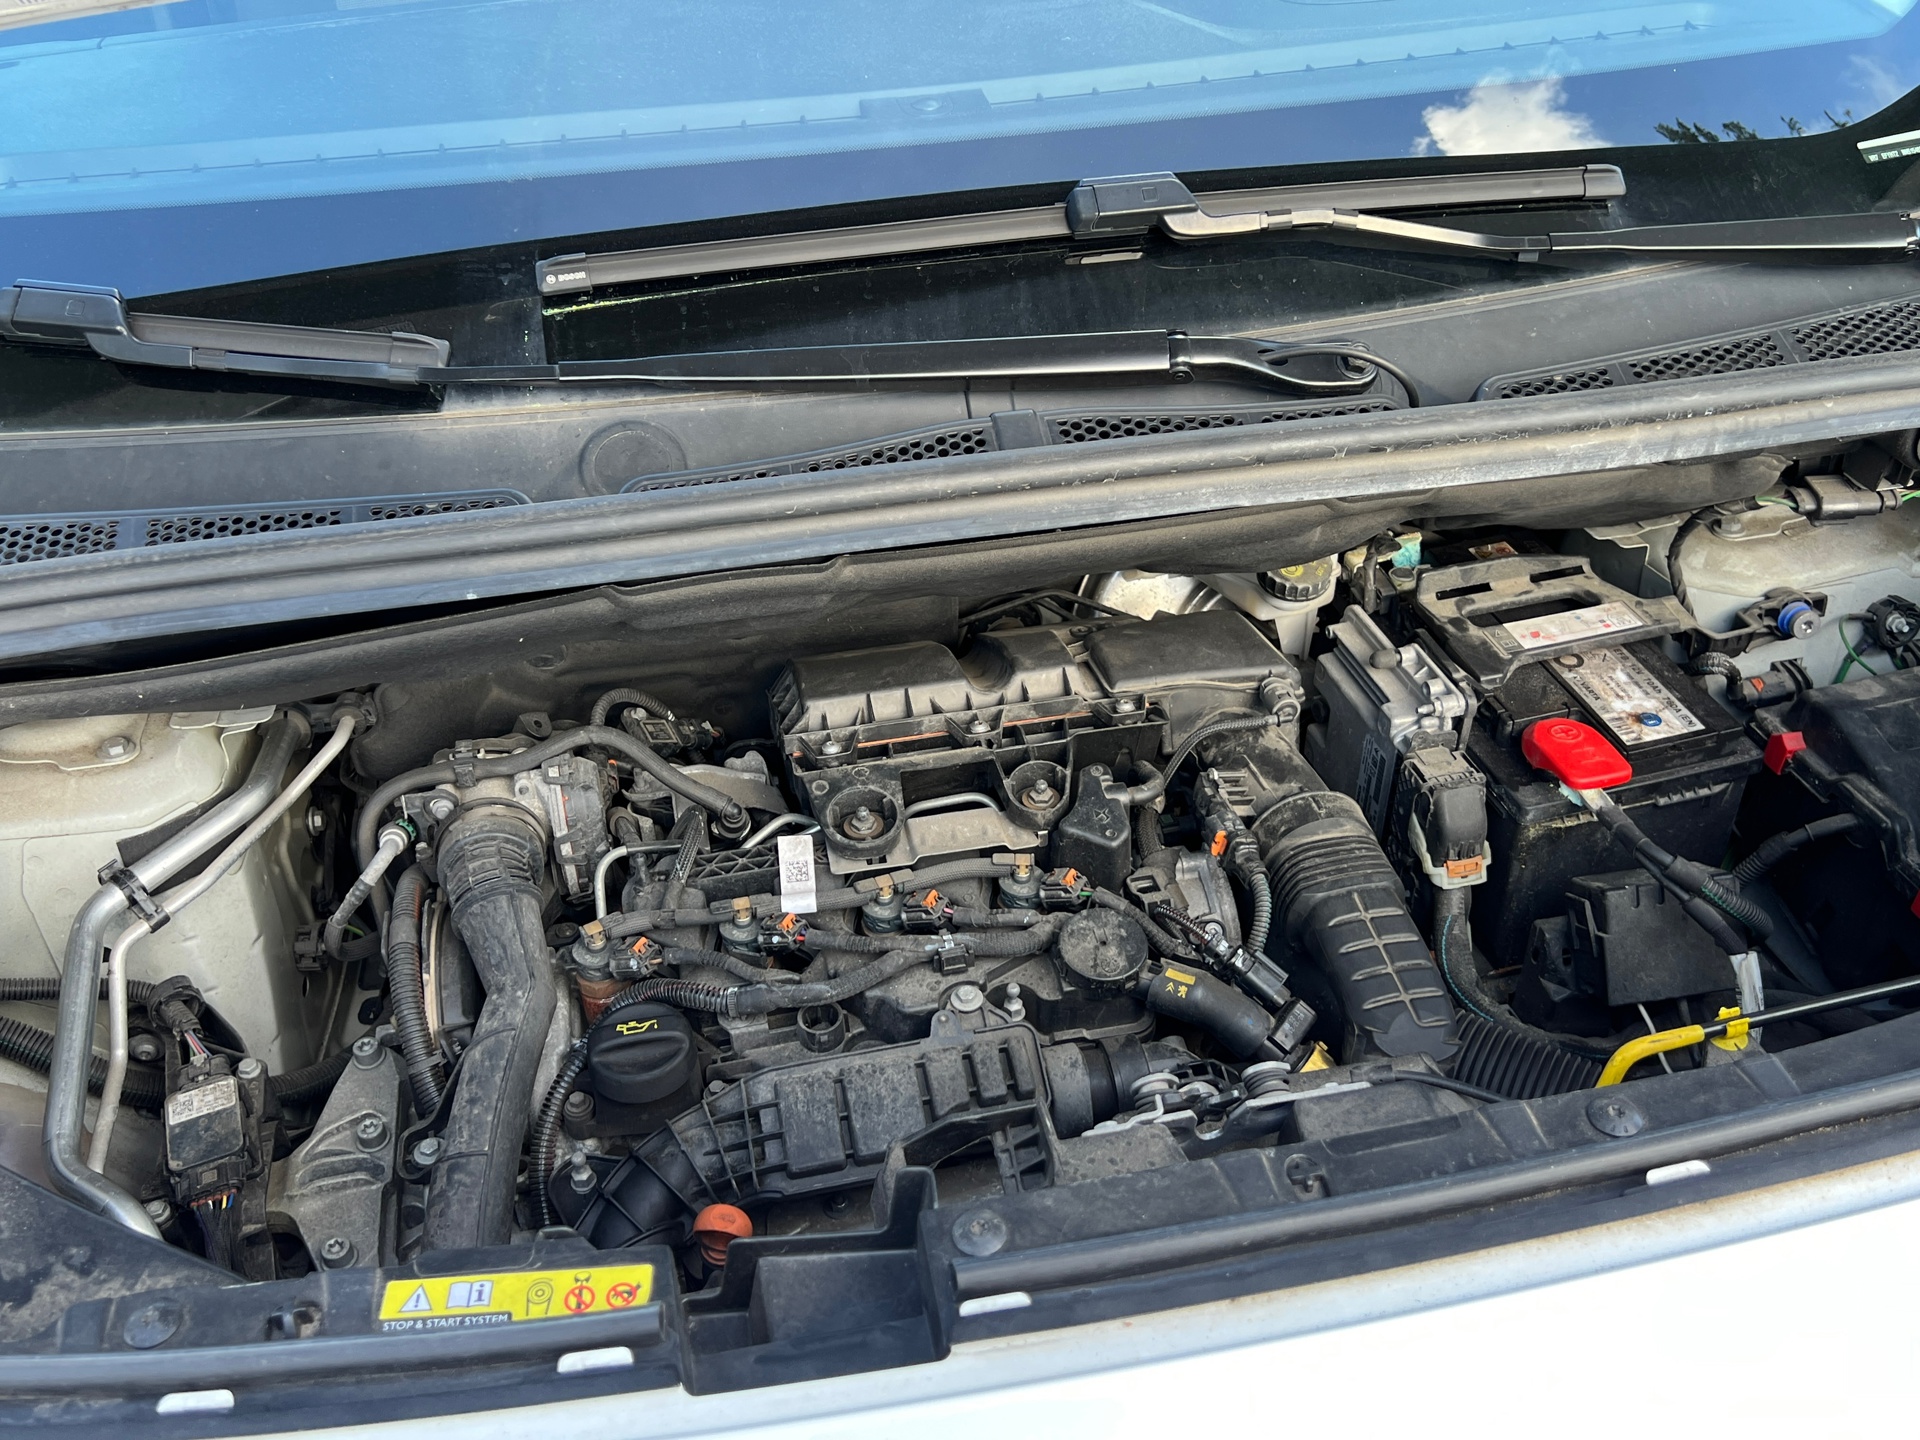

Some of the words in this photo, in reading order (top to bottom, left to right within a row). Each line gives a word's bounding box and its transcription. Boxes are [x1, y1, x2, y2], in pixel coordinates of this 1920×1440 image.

[557, 271, 586, 282] BOSCH
[1643, 677, 1662, 694] 70Ah
[1679, 713, 1697, 728] (EN)
[382, 1320, 414, 1332] STOP
[415, 1320, 424, 1329] &
[426, 1317, 463, 1328] START
[464, 1313, 509, 1326] SYSTEM
